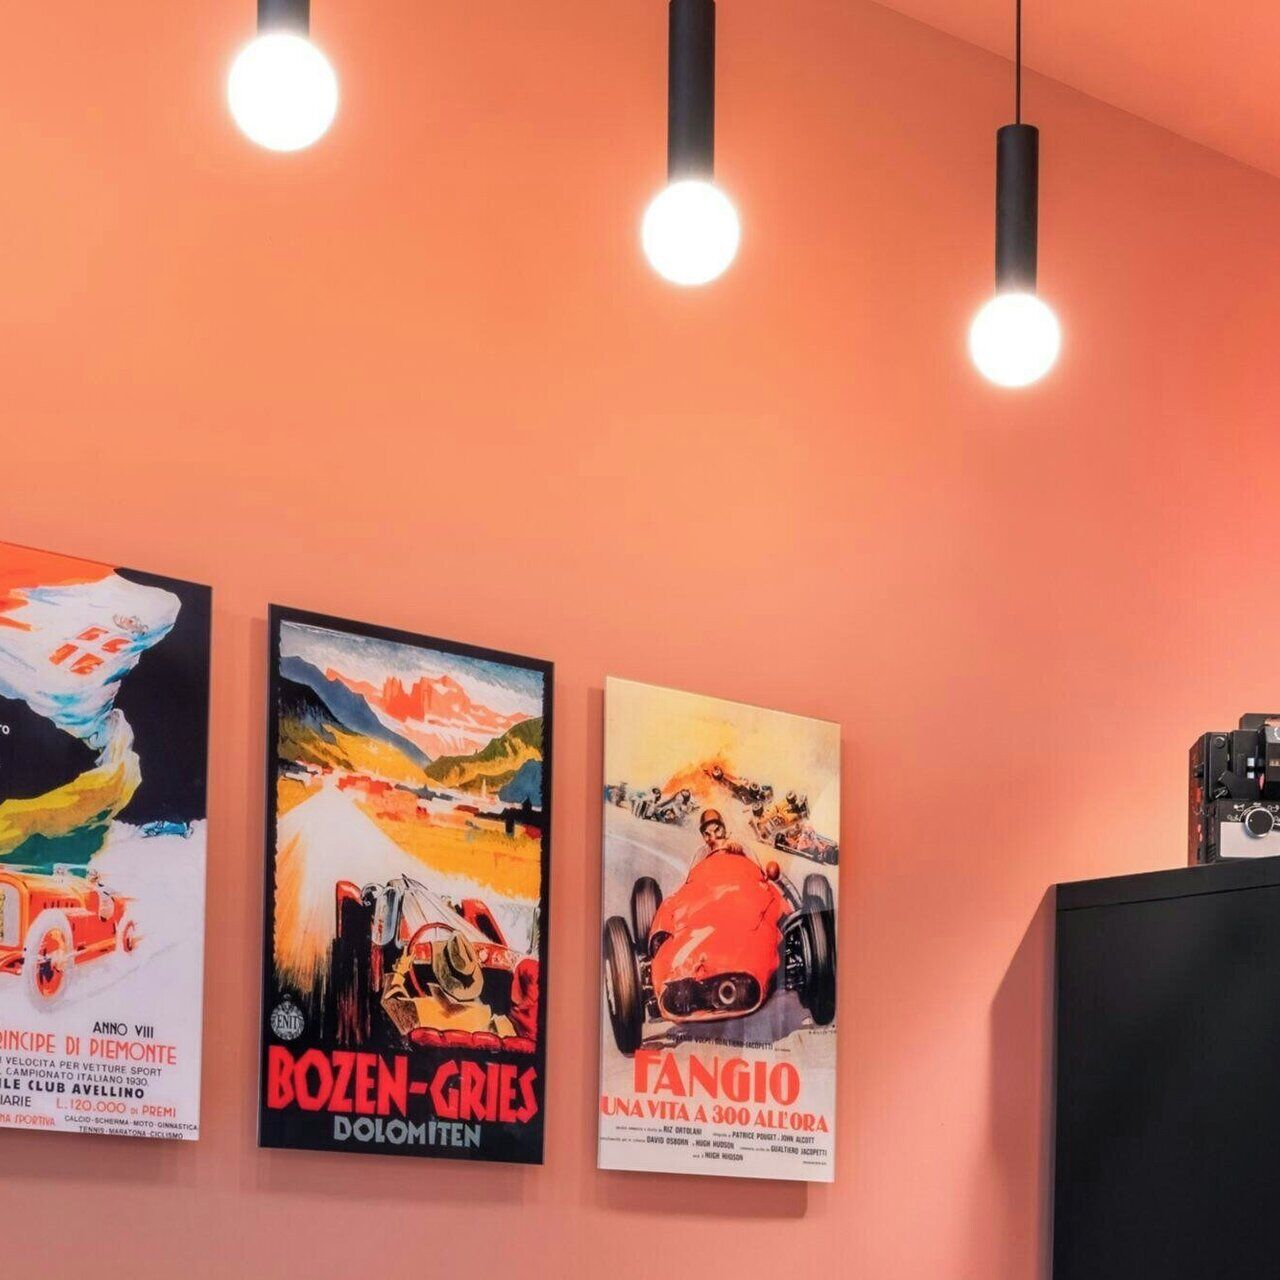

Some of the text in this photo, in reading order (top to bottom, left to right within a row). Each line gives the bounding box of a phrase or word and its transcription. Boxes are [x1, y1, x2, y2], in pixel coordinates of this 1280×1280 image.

[671, 925, 714, 971] 1
[93, 1021, 154, 1039] ANNO VIII
[66, 1036, 80, 1056] DI
[90, 1038, 177, 1066] PIEMONTE
[6, 1068, 74, 1080] CAMPIONATO
[77, 1072, 123, 1084] ITALIANO
[59, 1060, 80, 1069] PER
[82, 1063, 127, 1074] VETTURE
[130, 1067, 163, 1077] SPORT
[267, 1044, 539, 1123] BOZEN-GRIES
[634, 1049, 800, 1106] FANGIO
[28, 1080, 65, 1093] CLUB
[72, 1083, 144, 1099] AVELLINO
[142, 1104, 176, 1118] PREMI
[599, 1096, 644, 1118] UNA
[645, 1098, 690, 1121] VITA
[693, 1105, 708, 1123] A
[712, 1104, 751, 1127] 300
[333, 1115, 482, 1149] DOLOMITEN
